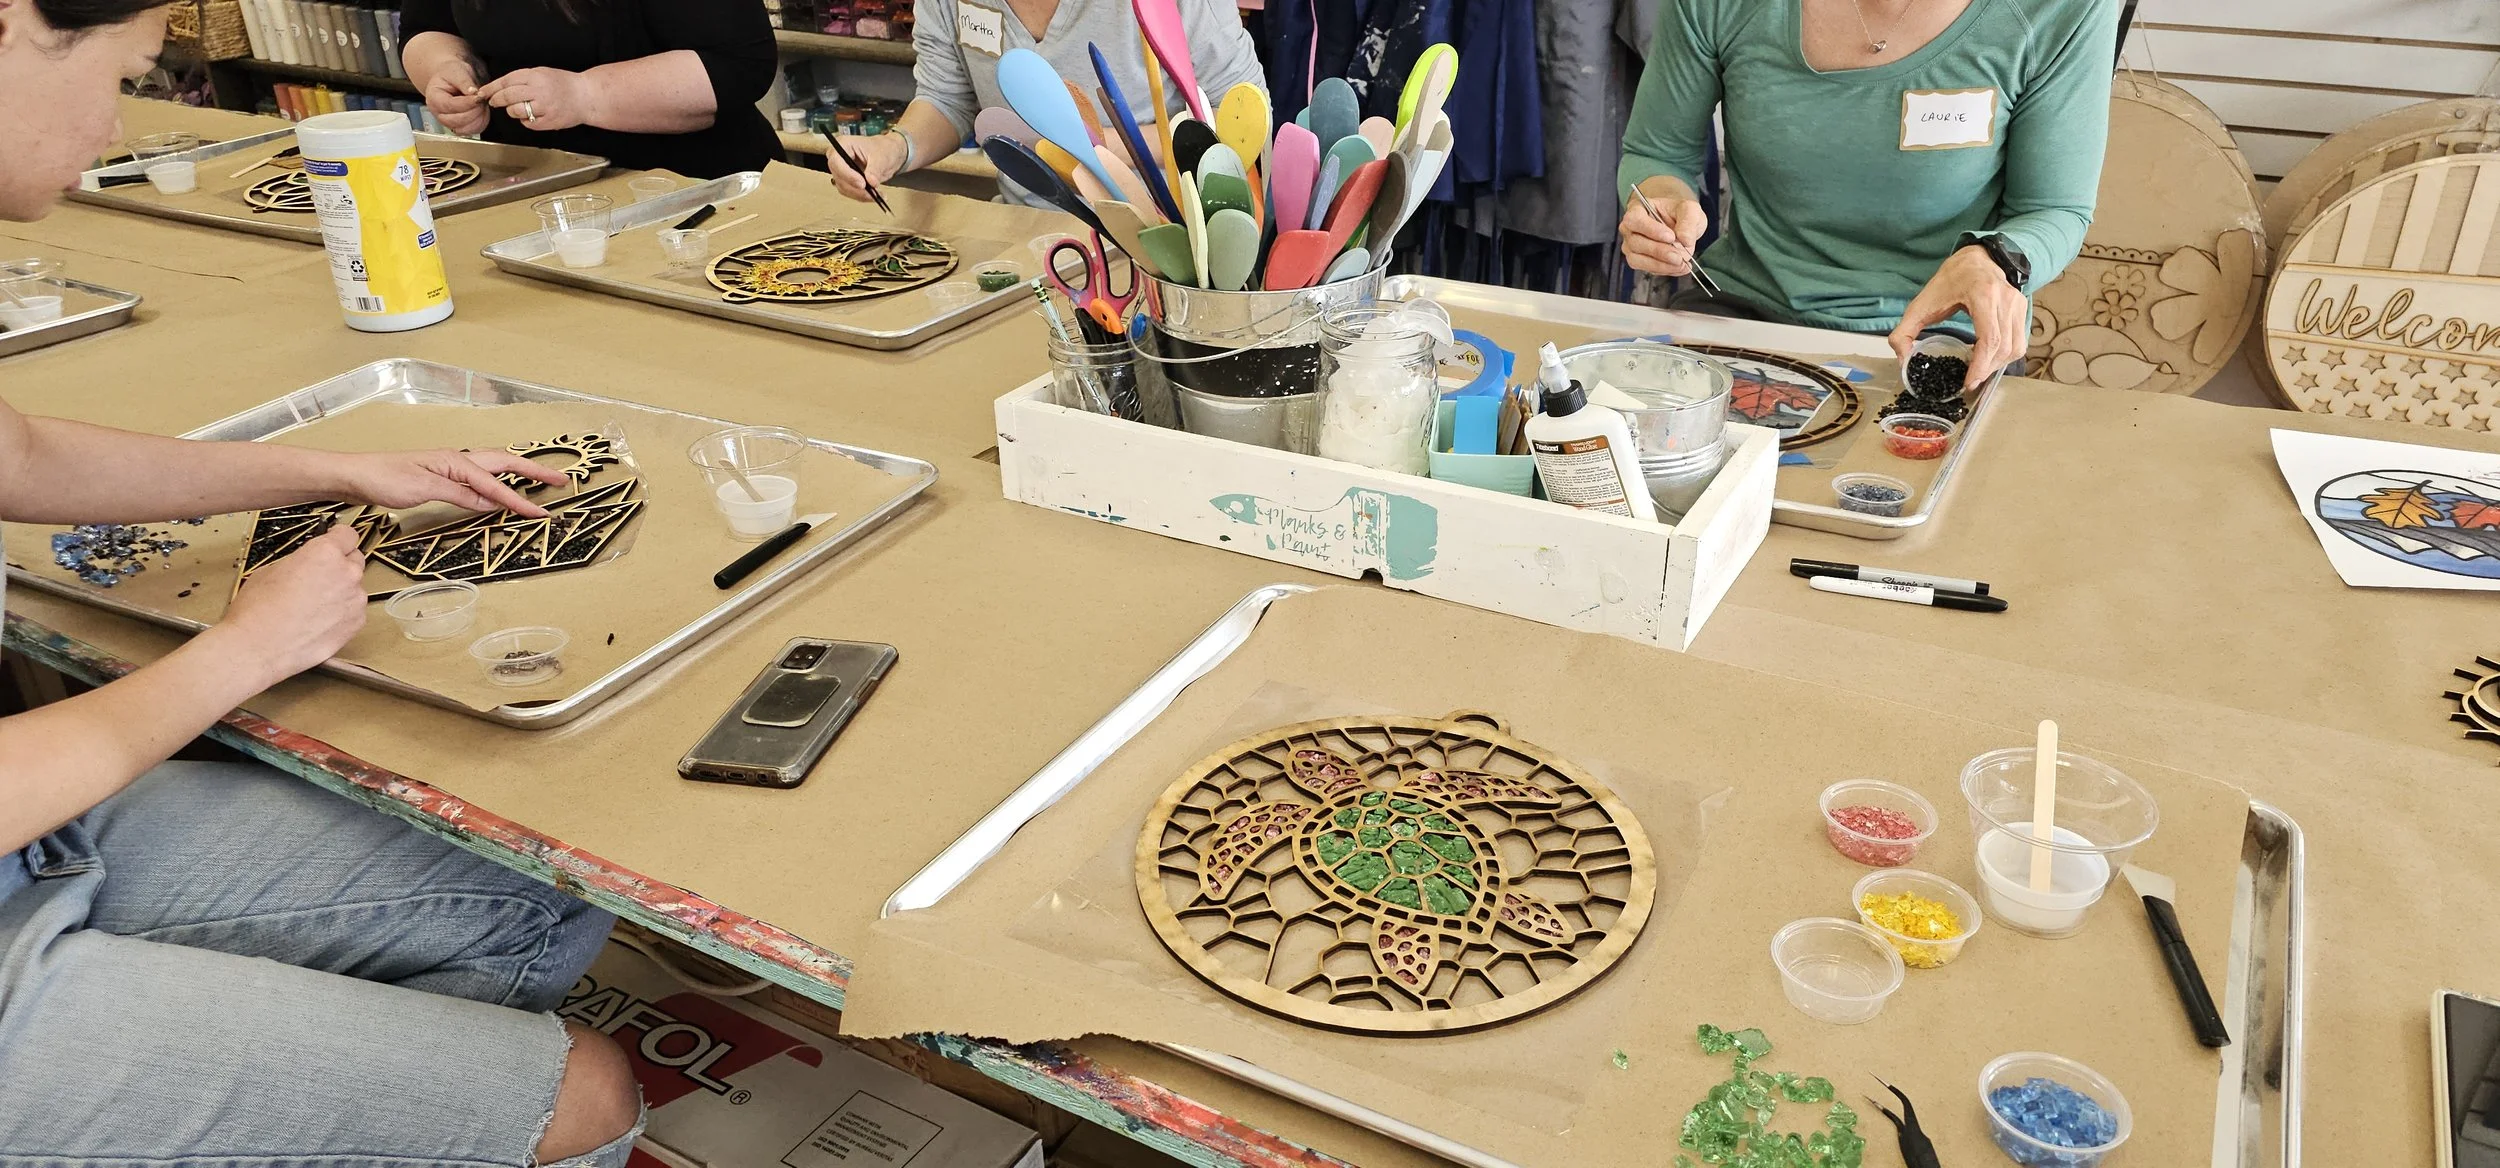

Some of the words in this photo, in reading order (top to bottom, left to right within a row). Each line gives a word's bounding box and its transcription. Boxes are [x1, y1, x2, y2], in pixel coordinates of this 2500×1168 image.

[961, 15, 995, 39] Martha
[1920, 112, 1968, 123] LAURIE
[398, 164, 410, 176] 78
